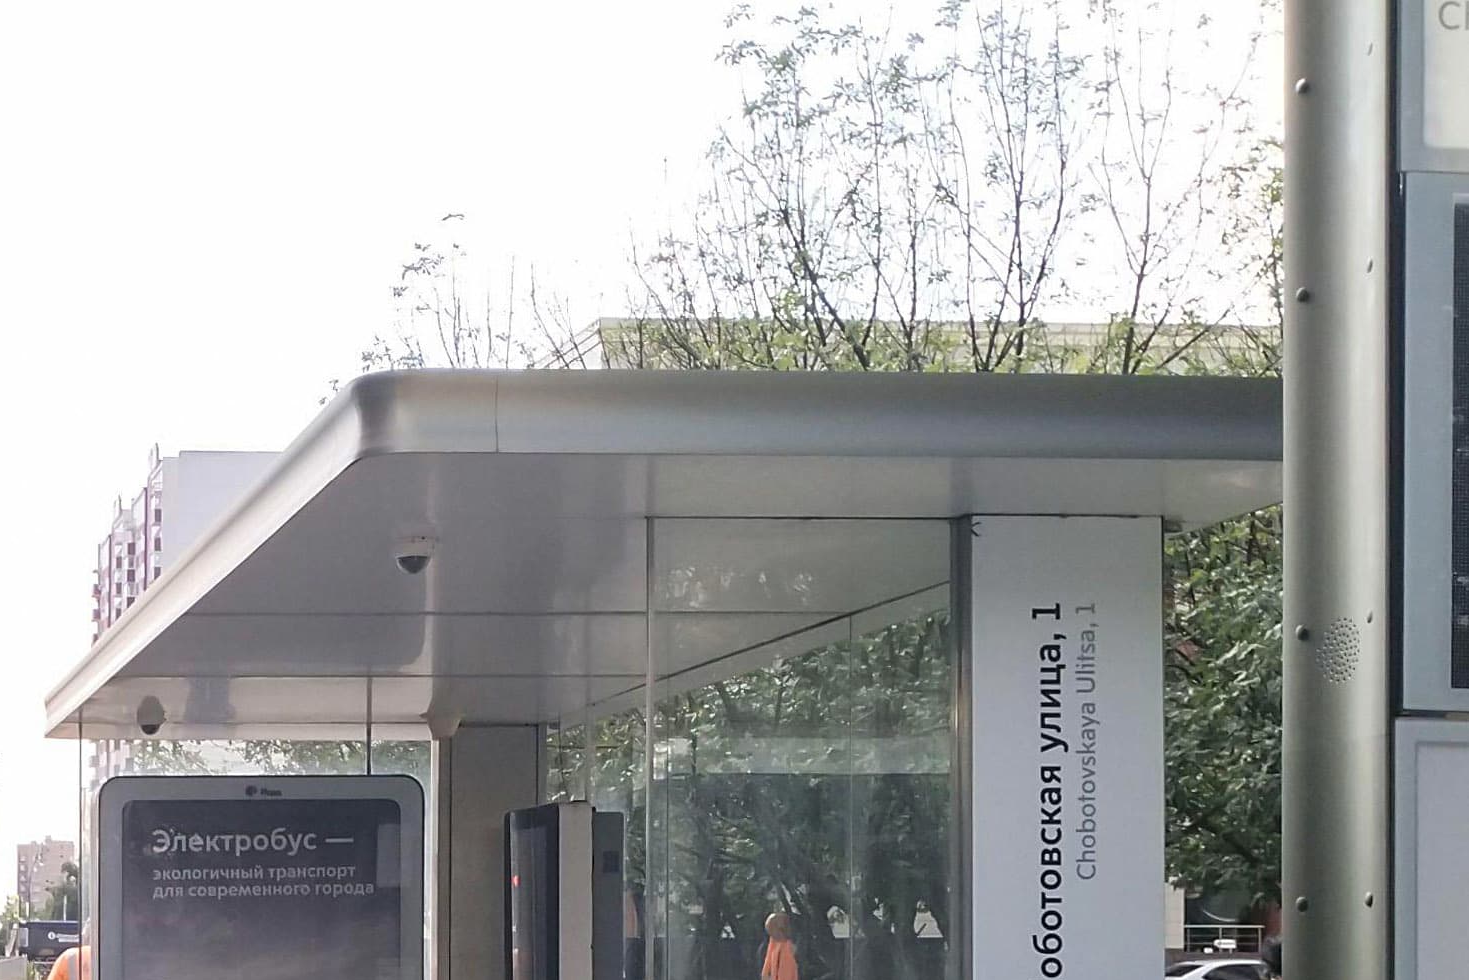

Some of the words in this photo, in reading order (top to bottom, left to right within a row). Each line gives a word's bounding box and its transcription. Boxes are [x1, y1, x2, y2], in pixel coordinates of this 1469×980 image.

[1032, 603, 1061, 620] 1
[1075, 603, 1096, 615] 1
[1075, 623, 1100, 694] Ulitsa,
[1040, 633, 1069, 753] улица,
[1075, 702, 1101, 880] Chobotovskaya
[152, 827, 318, 856] Электробус
[152, 865, 265, 882] экологичный
[268, 865, 356, 882] транспорт
[152, 885, 183, 899] для
[187, 884, 311, 900] современного
[314, 882, 375, 898] города
